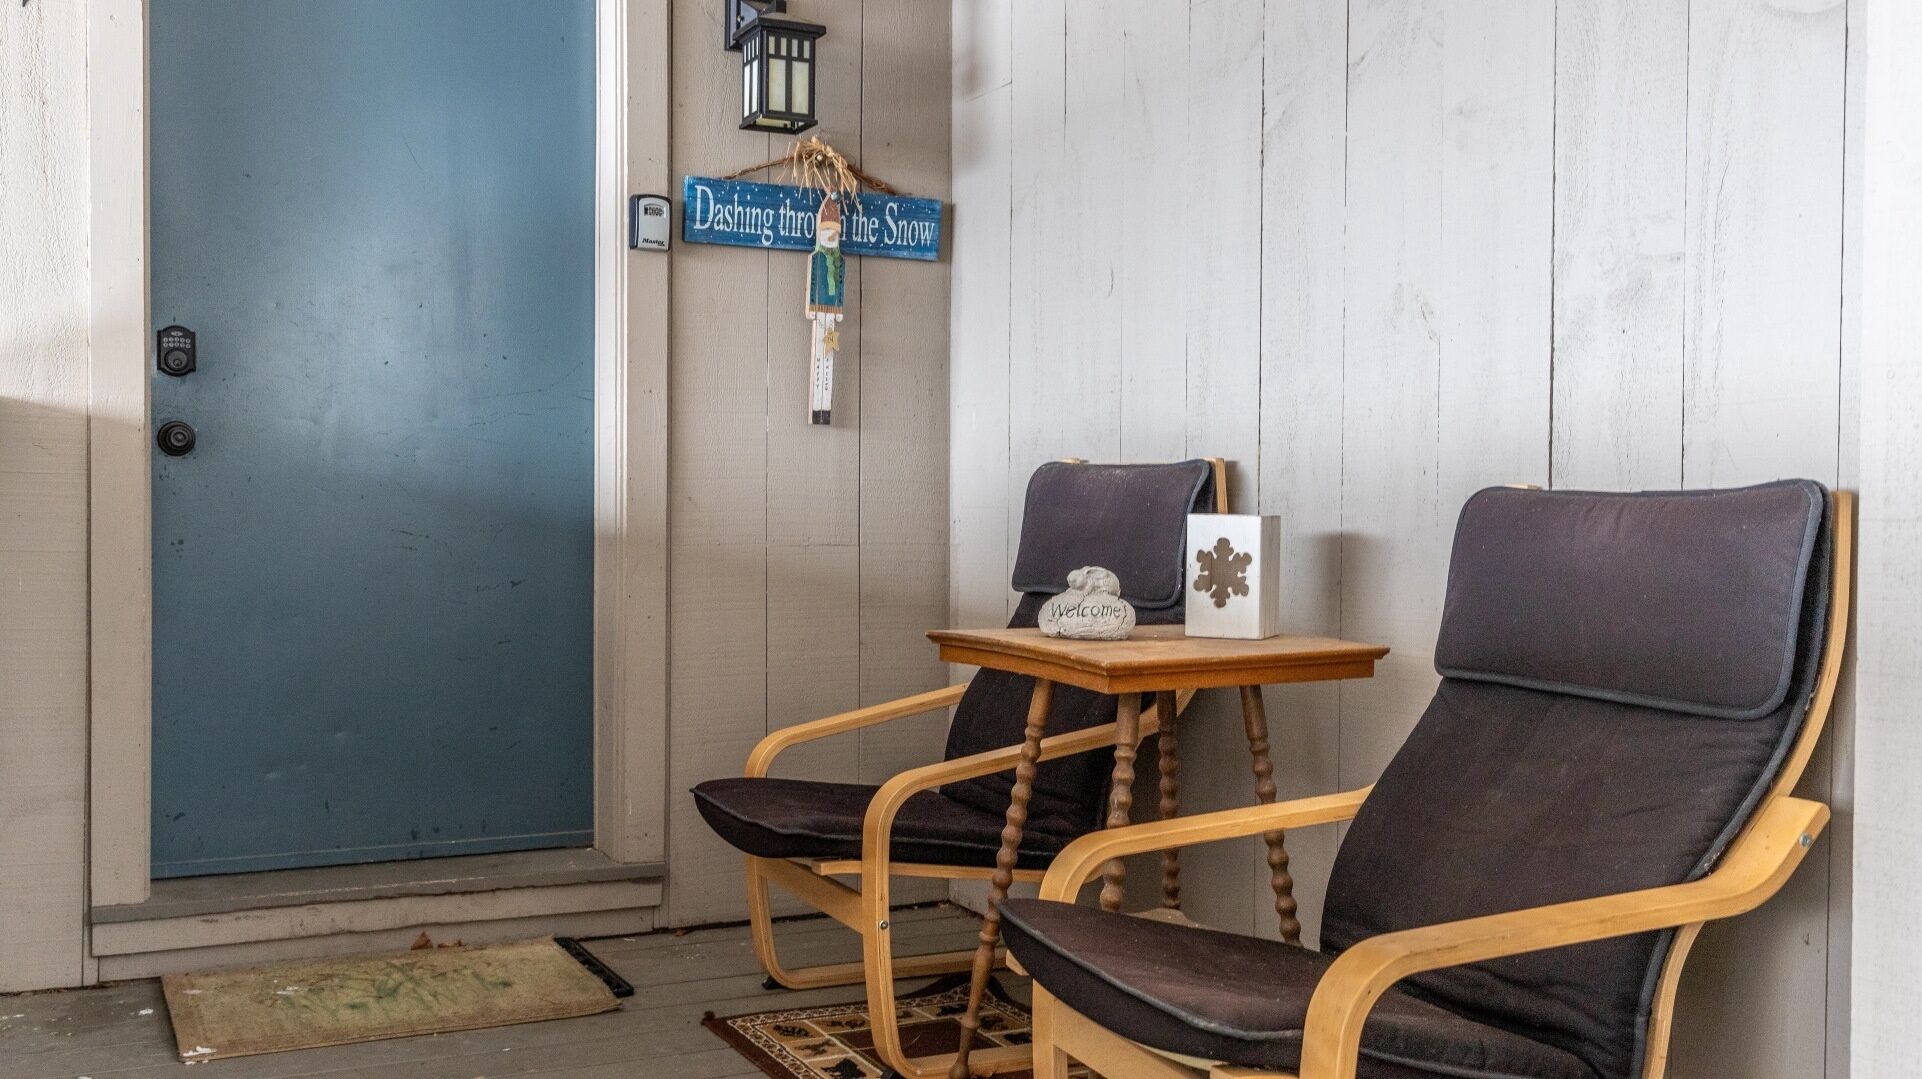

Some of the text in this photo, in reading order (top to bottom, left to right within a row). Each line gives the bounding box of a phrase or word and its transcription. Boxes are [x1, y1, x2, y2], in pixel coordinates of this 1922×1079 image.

[693, 185, 774, 246] Dashing
[852, 204, 879, 243] the
[884, 202, 934, 247] Snow
[1051, 602, 1121, 618] Welcome
